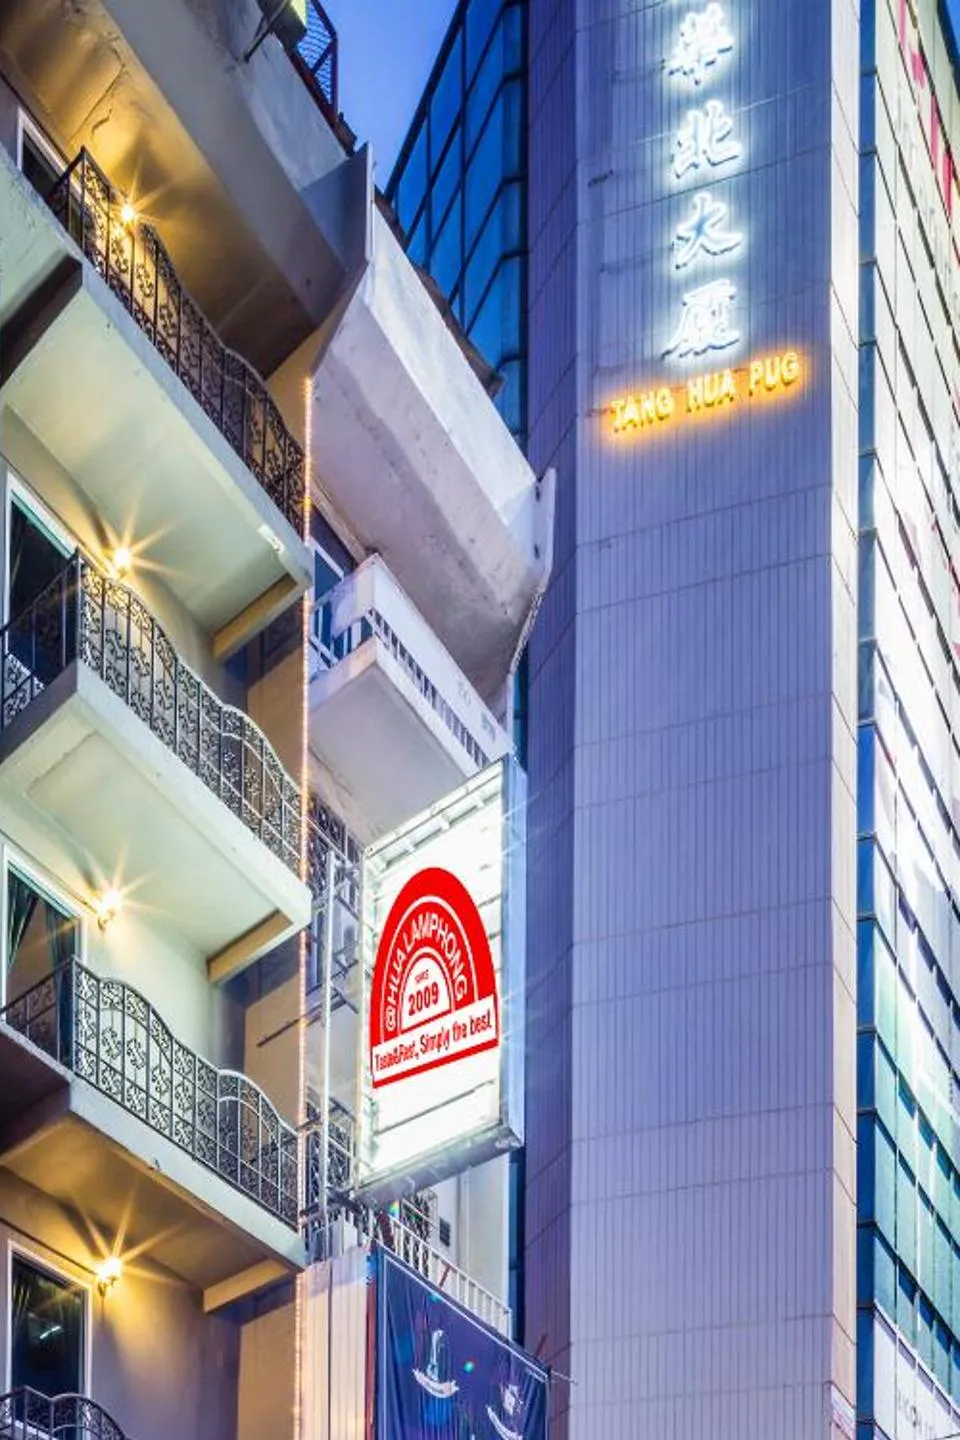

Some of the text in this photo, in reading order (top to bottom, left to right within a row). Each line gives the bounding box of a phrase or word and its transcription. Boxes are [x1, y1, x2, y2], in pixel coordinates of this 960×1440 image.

[611, 352, 799, 432] TANG HUA PUG
[403, 912, 468, 1001] LAMPHONG
[408, 981, 439, 1016] 2009
[420, 1025, 450, 1054] Simply
[453, 1020, 467, 1042] the
[469, 1008, 492, 1036] best
